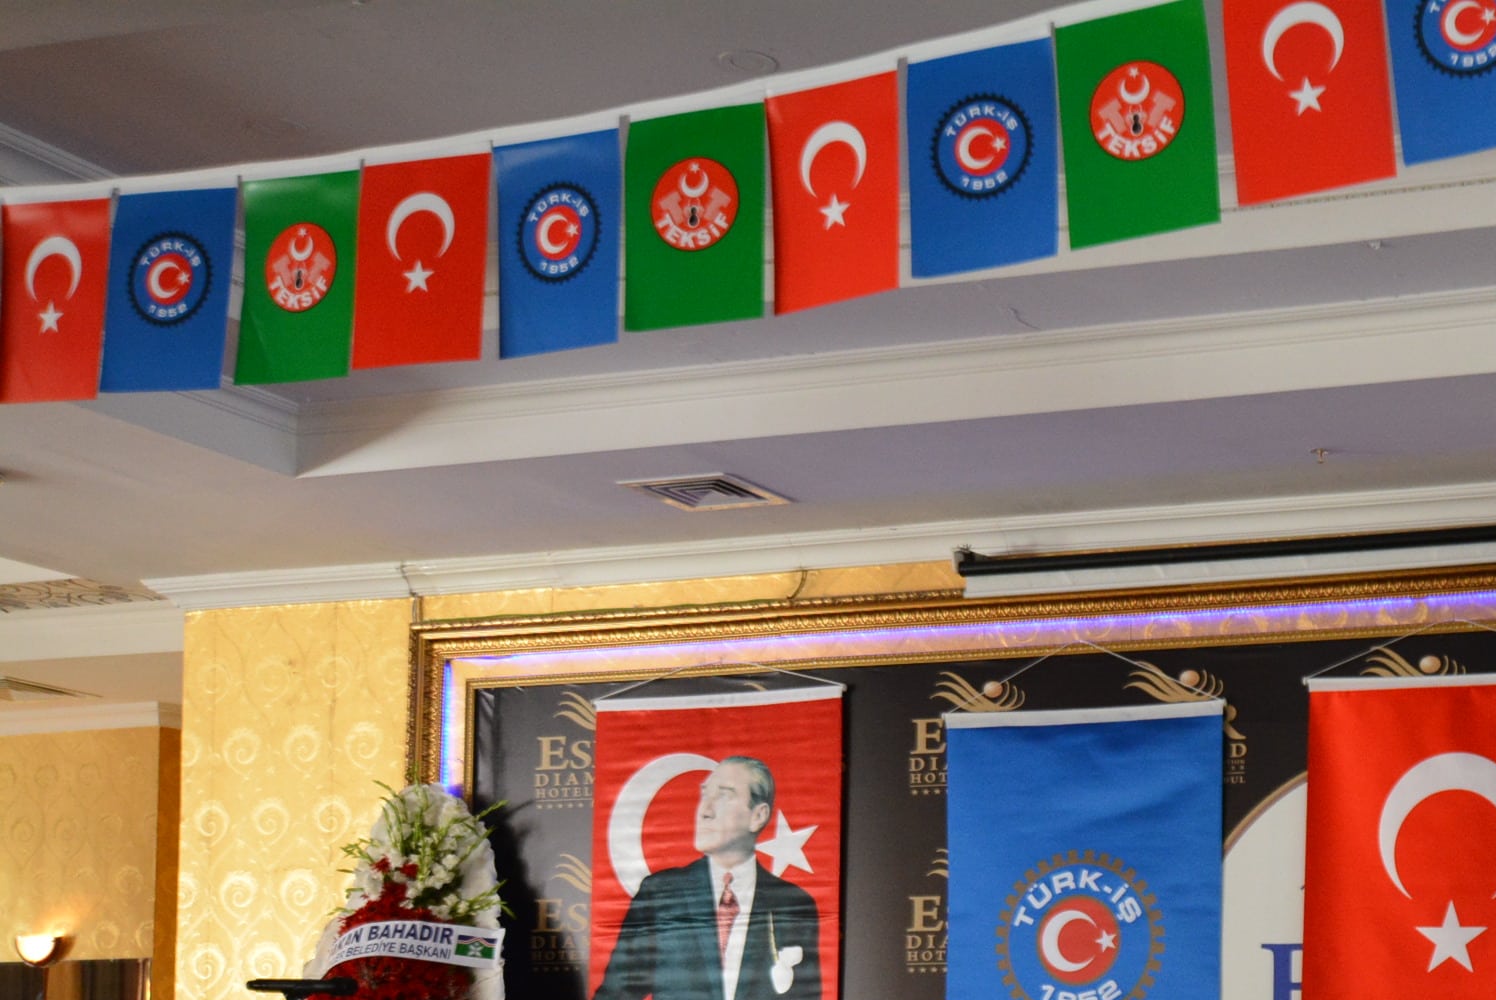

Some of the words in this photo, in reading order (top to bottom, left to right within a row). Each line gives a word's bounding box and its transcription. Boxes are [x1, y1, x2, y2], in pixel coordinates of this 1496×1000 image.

[946, 104, 1018, 137] TÜRK-İŞ
[961, 171, 1008, 190] 1952
[529, 192, 590, 222] TÜRK-İŞ
[540, 256, 579, 274] 1952
[149, 303, 187, 318] 1952
[1013, 869, 1143, 927] TÜRK-İŞ
[368, 924, 454, 945] BAHADIR
[346, 940, 397, 958] BELEDİYE
[400, 942, 452, 960] BAŞKANI
